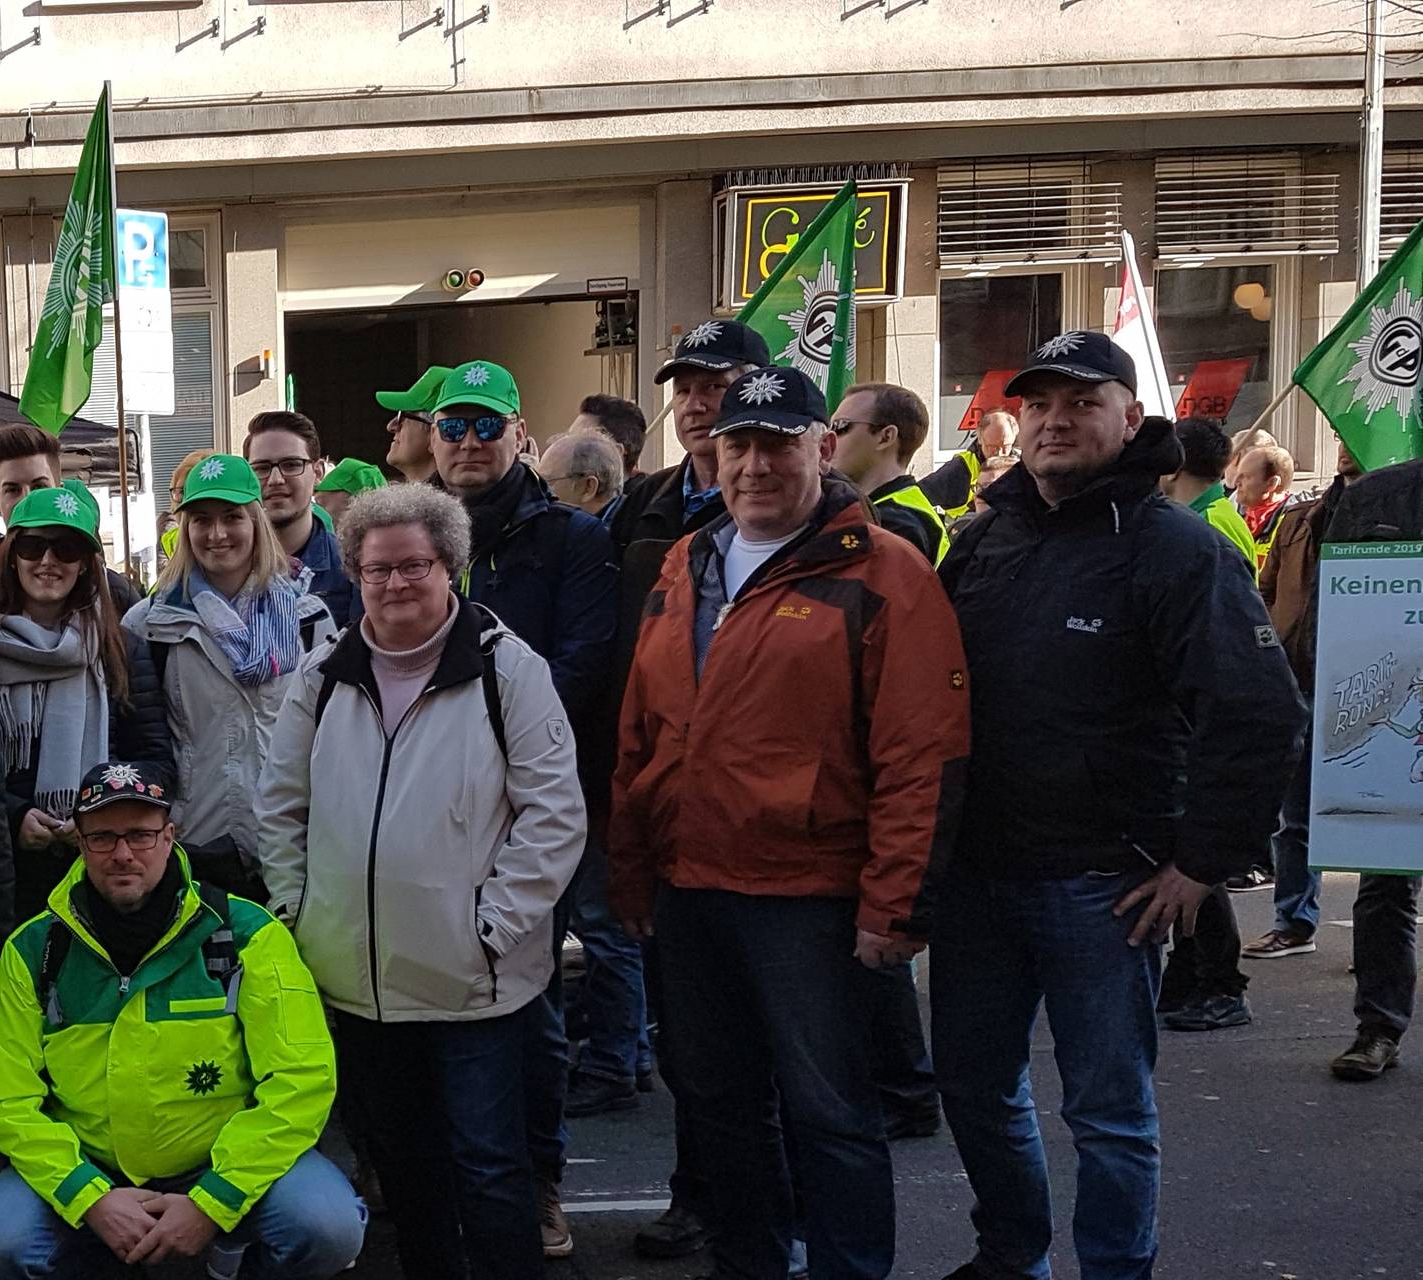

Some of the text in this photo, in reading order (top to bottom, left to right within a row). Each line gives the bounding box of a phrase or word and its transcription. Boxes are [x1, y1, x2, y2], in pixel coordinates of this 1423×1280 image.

[1330, 543, 1422, 555] Tarifrunde 2019
[1330, 575, 1423, 595] Keinen
